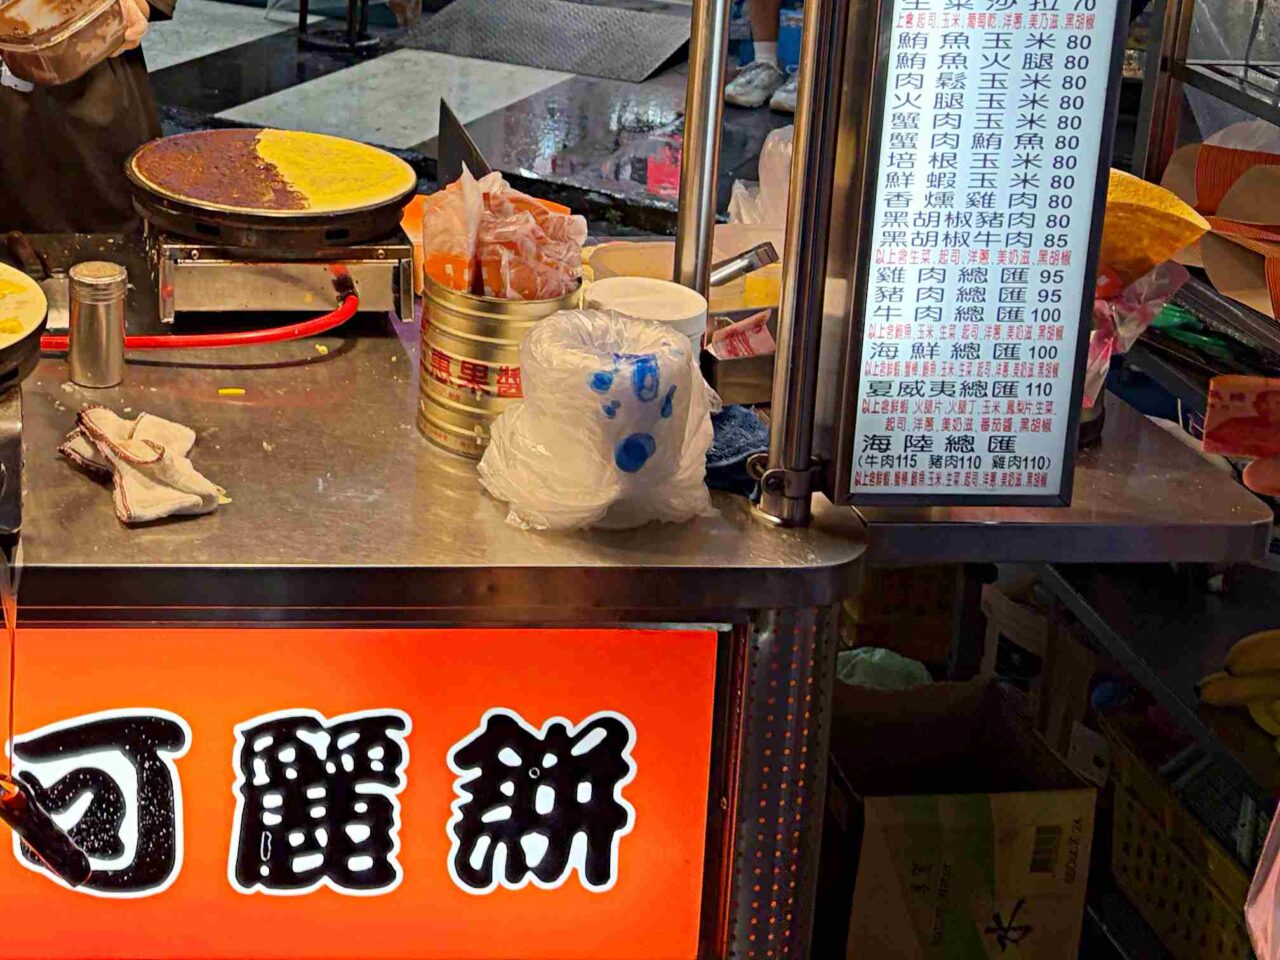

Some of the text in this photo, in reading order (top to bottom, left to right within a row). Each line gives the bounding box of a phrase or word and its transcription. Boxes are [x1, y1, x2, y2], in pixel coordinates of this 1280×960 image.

[898, 33, 1091, 50] 鮪魚玉米 80
[896, 53, 1089, 70] 鮪魚火腿 80
[895, 73, 1086, 90] 肉鬆玉米 80
[892, 93, 1084, 110] 火腿玉米 80
[890, 113, 1082, 130] 蟹肉玉米 80
[889, 133, 1079, 150] 蟹肉鮪魚 80
[887, 153, 1077, 169] 培根玉米 80
[885, 173, 1074, 189] 鮮蝦玉米 80
[1048, 195, 1072, 209] 80
[882, 212, 1070, 228] 黑胡椒豬肉 80
[880, 231, 1068, 247] 黑胡椒牛肉 85
[876, 268, 1064, 284] 雞肉總匯 95
[874, 287, 1062, 304] 豬肉總匯 95
[872, 306, 1061, 322] 牛肉總匯 100
[870, 343, 1057, 360] 海鮮總匯 100
[866, 381, 1052, 398] 夏威夷總匯 110
[862, 434, 1016, 454] 海陸總匯
[928, 455, 981, 470] 豬肉110
